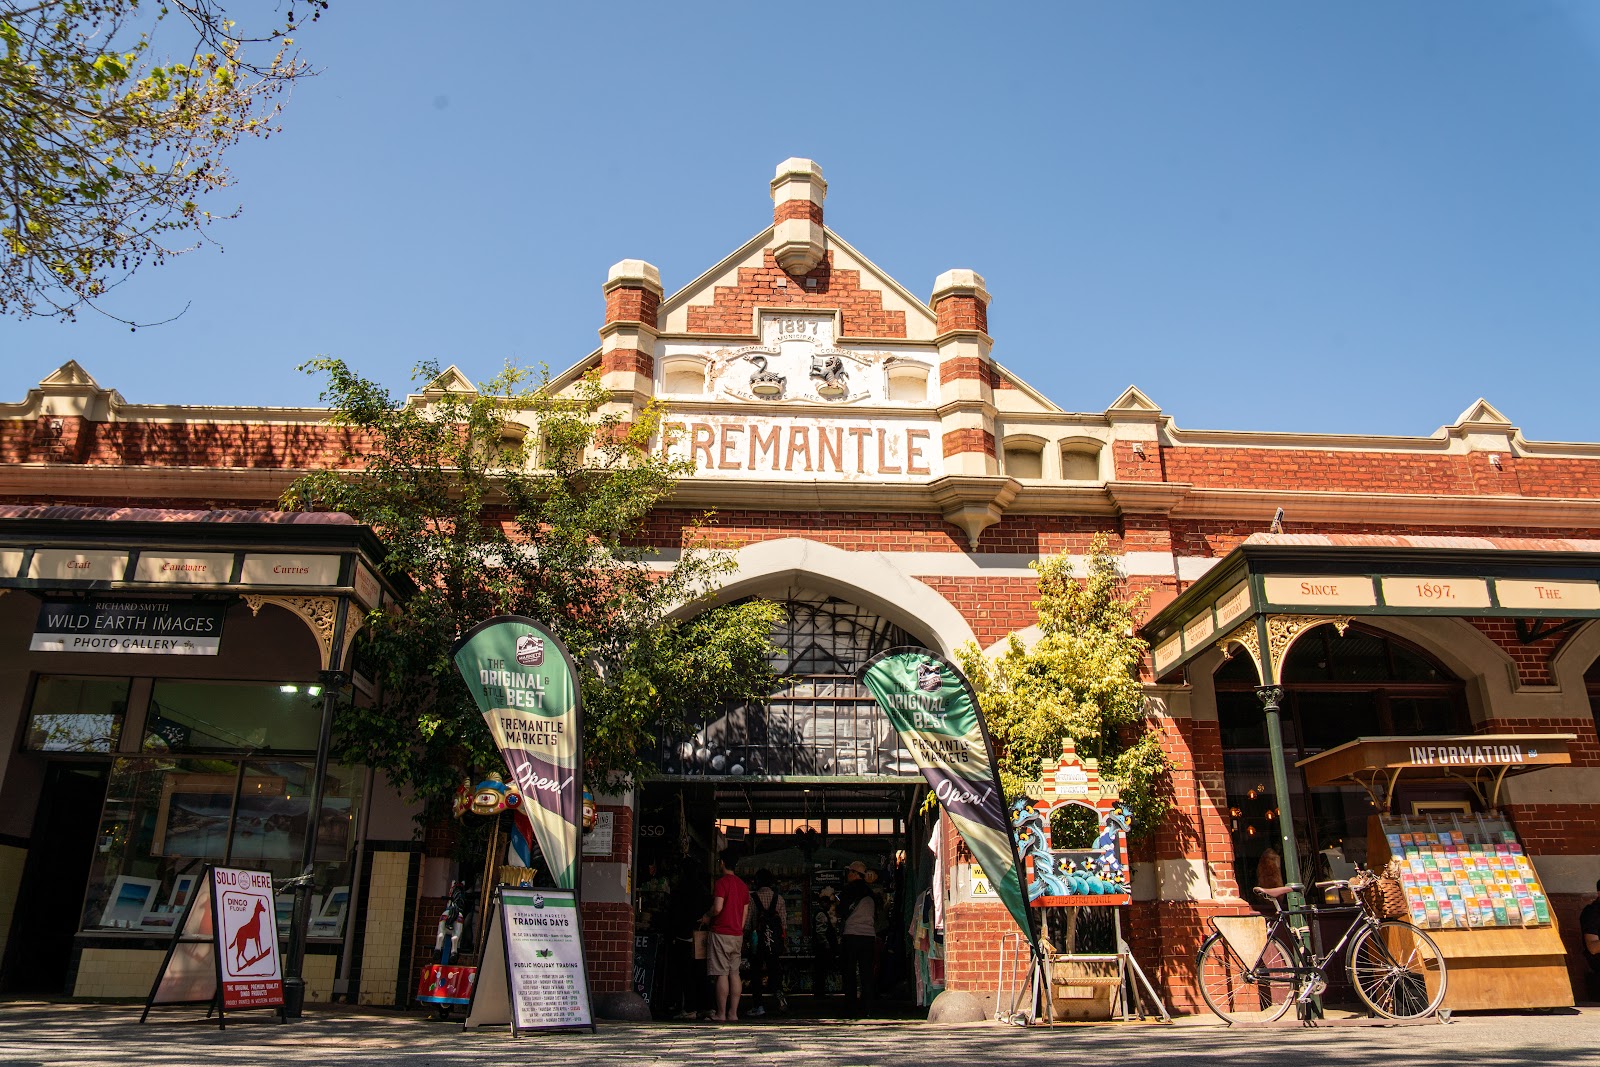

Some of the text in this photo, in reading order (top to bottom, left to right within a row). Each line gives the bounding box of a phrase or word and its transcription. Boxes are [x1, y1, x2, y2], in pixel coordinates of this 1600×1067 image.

[777, 319, 818, 335] 1897
[777, 334, 816, 342] MUNICIPAL
[661, 421, 931, 476] FREMANTLE
[66, 560, 91, 569] Craft
[162, 562, 207, 571] Caneware
[273, 565, 309, 574] Curries
[1416, 583, 1456, 600] 1897,
[95, 602, 169, 612] RICHARD SMYTH
[48, 614, 214, 632] WILD EARTH IMAGES
[73, 637, 178, 649] PHOTO GALLERY
[488, 658, 505, 669] THE
[479, 669, 545, 690] ORIGINAL
[893, 682, 909, 692] THE
[506, 689, 546, 709] BEST
[888, 693, 946, 711] ORIGINAL
[500, 717, 564, 734] FREMANTLE
[913, 711, 948, 729] BEST
[506, 731, 558, 746] MARKETS
[911, 738, 972, 751] FREMANTLE
[921, 751, 969, 763] MARKETS
[1409, 745, 1523, 765] INFORMATION
[515, 761, 574, 795] Open!
[935, 778, 993, 808] Open!
[216, 871, 237, 886] SOLD
[251, 874, 271, 889] HERE
[227, 898, 248, 907] DINGO
[513, 917, 569, 927] TRADING DAYS
